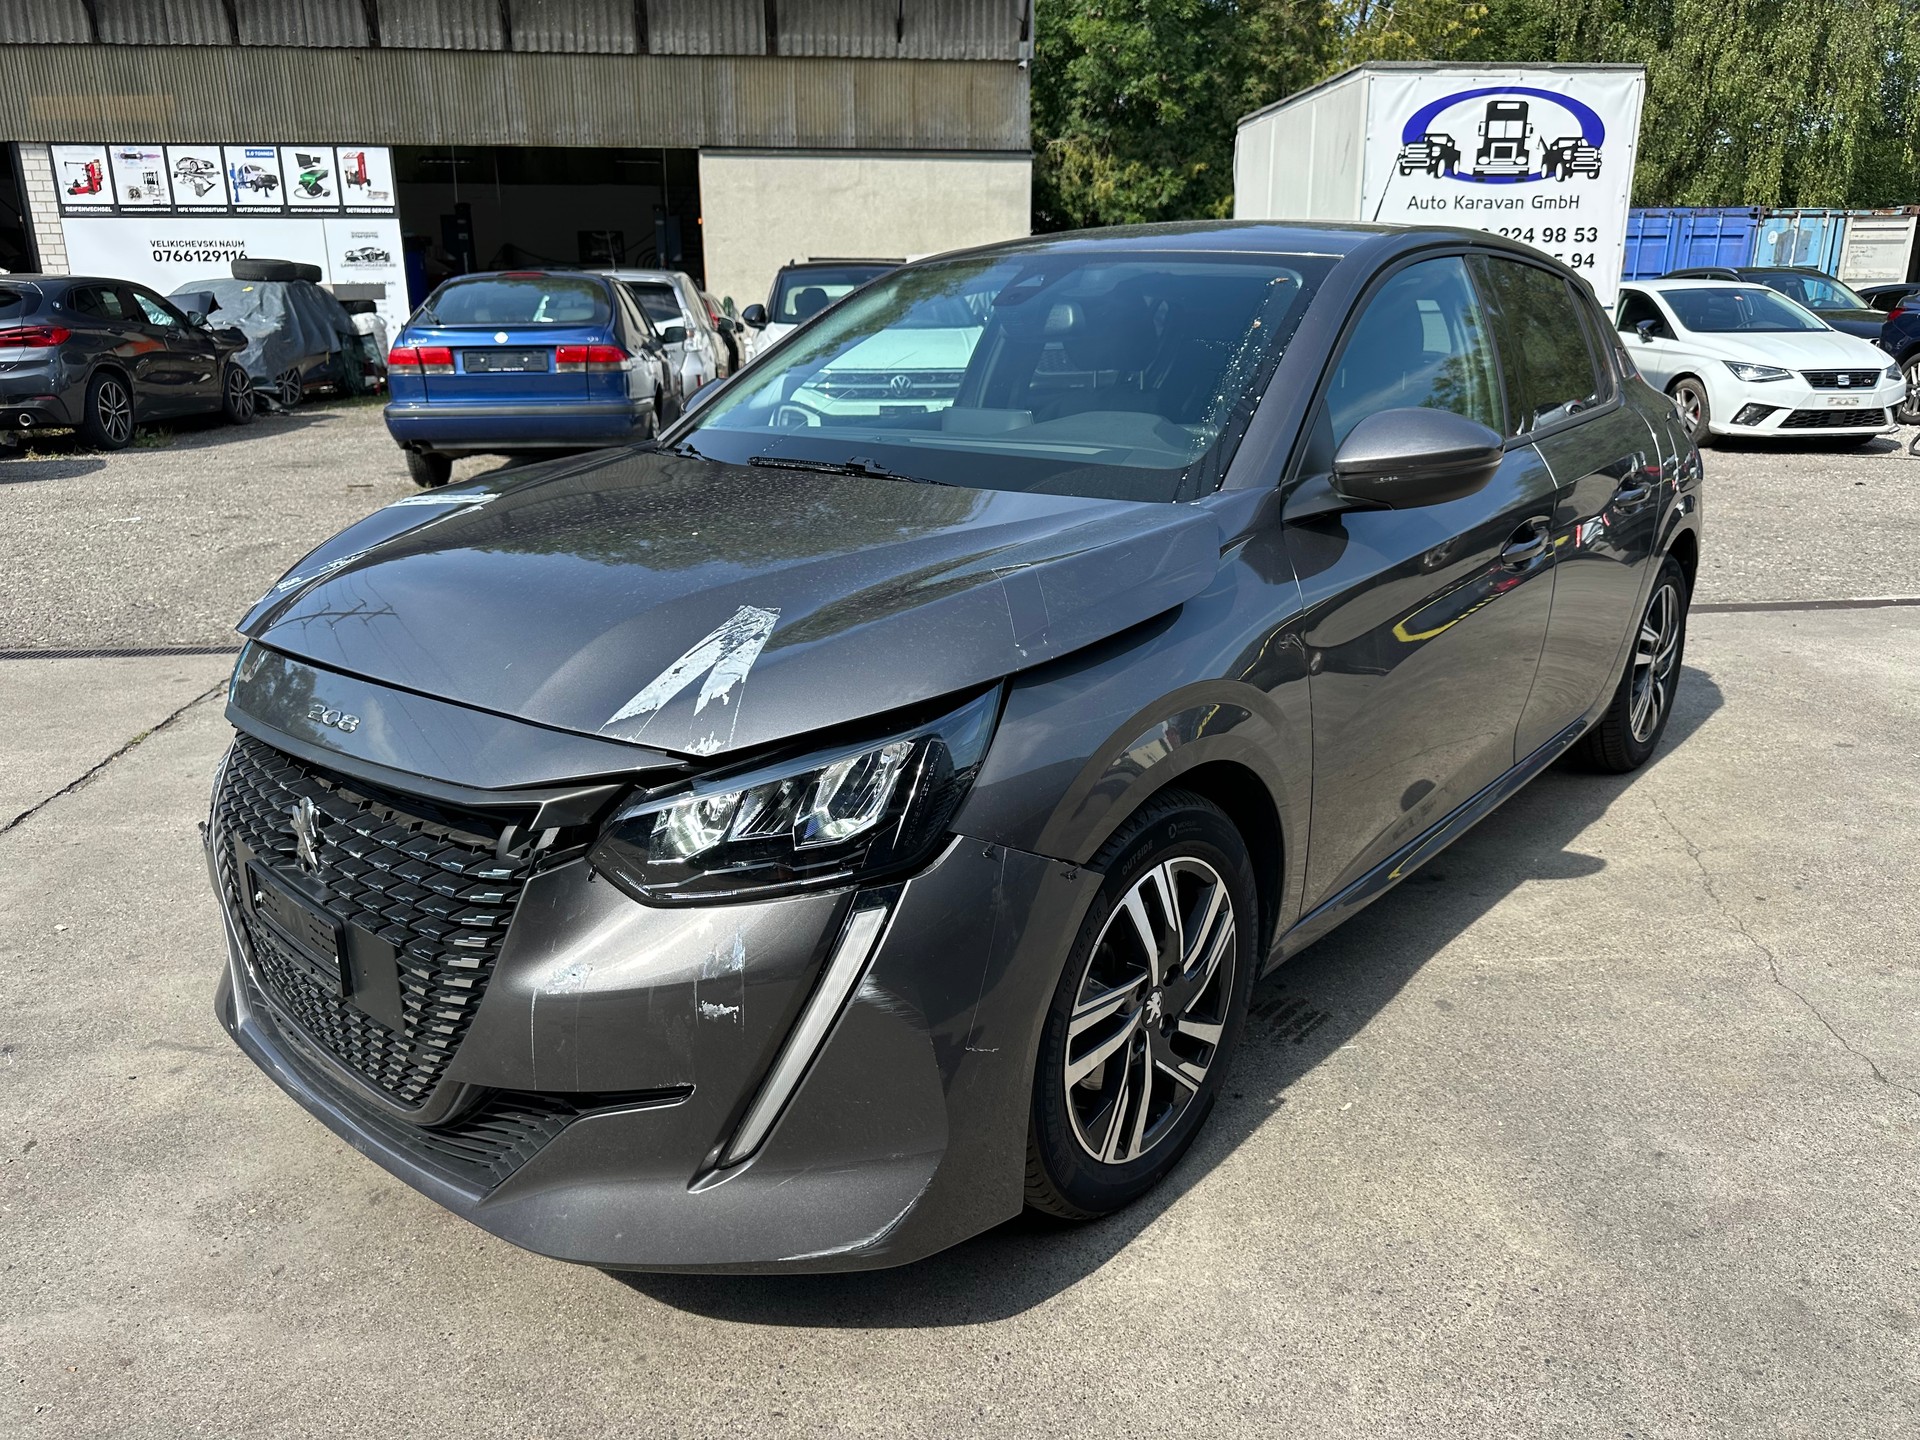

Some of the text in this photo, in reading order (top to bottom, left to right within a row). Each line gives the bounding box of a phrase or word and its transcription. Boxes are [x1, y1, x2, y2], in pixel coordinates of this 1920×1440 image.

[1407, 195, 1580, 210] Auto Karavan GmbH
[1542, 227, 1566, 243] 98
[1573, 227, 1598, 243] 53
[150, 240, 245, 248] VELIKICHEVSKI NAUM
[153, 250, 248, 262] 0766129116
[1571, 253, 1595, 268] 94
[307, 704, 360, 733] 208
[1121, 839, 1153, 875] OUTSIDE
[1093, 907, 1102, 923] 16
[1045, 1017, 1063, 1144] MICHELIN
